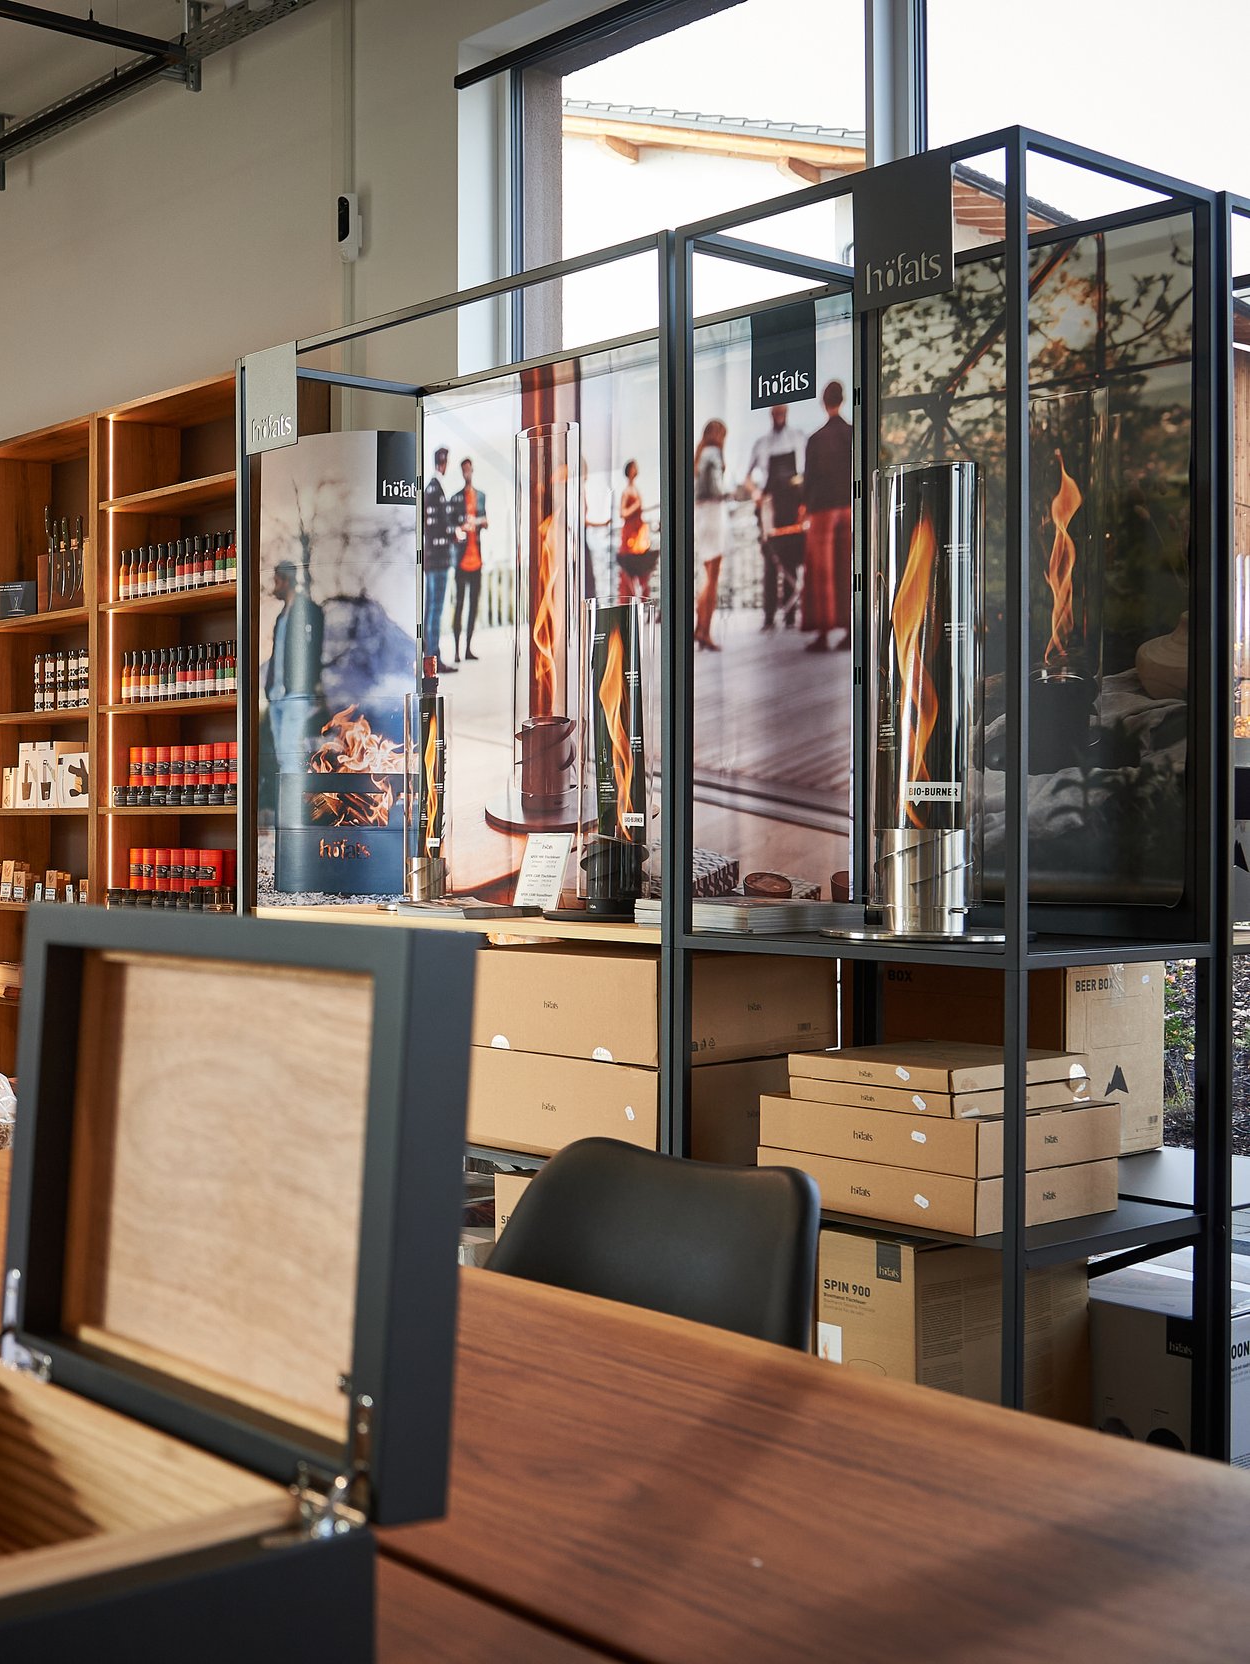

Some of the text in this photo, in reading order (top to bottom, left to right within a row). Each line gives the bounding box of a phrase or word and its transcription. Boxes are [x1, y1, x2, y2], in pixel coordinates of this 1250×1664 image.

[865, 251, 942, 296] höfats
[758, 369, 810, 399] höfats
[251, 413, 292, 443] höfats
[908, 787, 958, 797] BIO-BURNER
[887, 969, 913, 983] BOX
[1075, 977, 1114, 993] BEER BOX
[823, 1278, 871, 1298] SPIN 900
